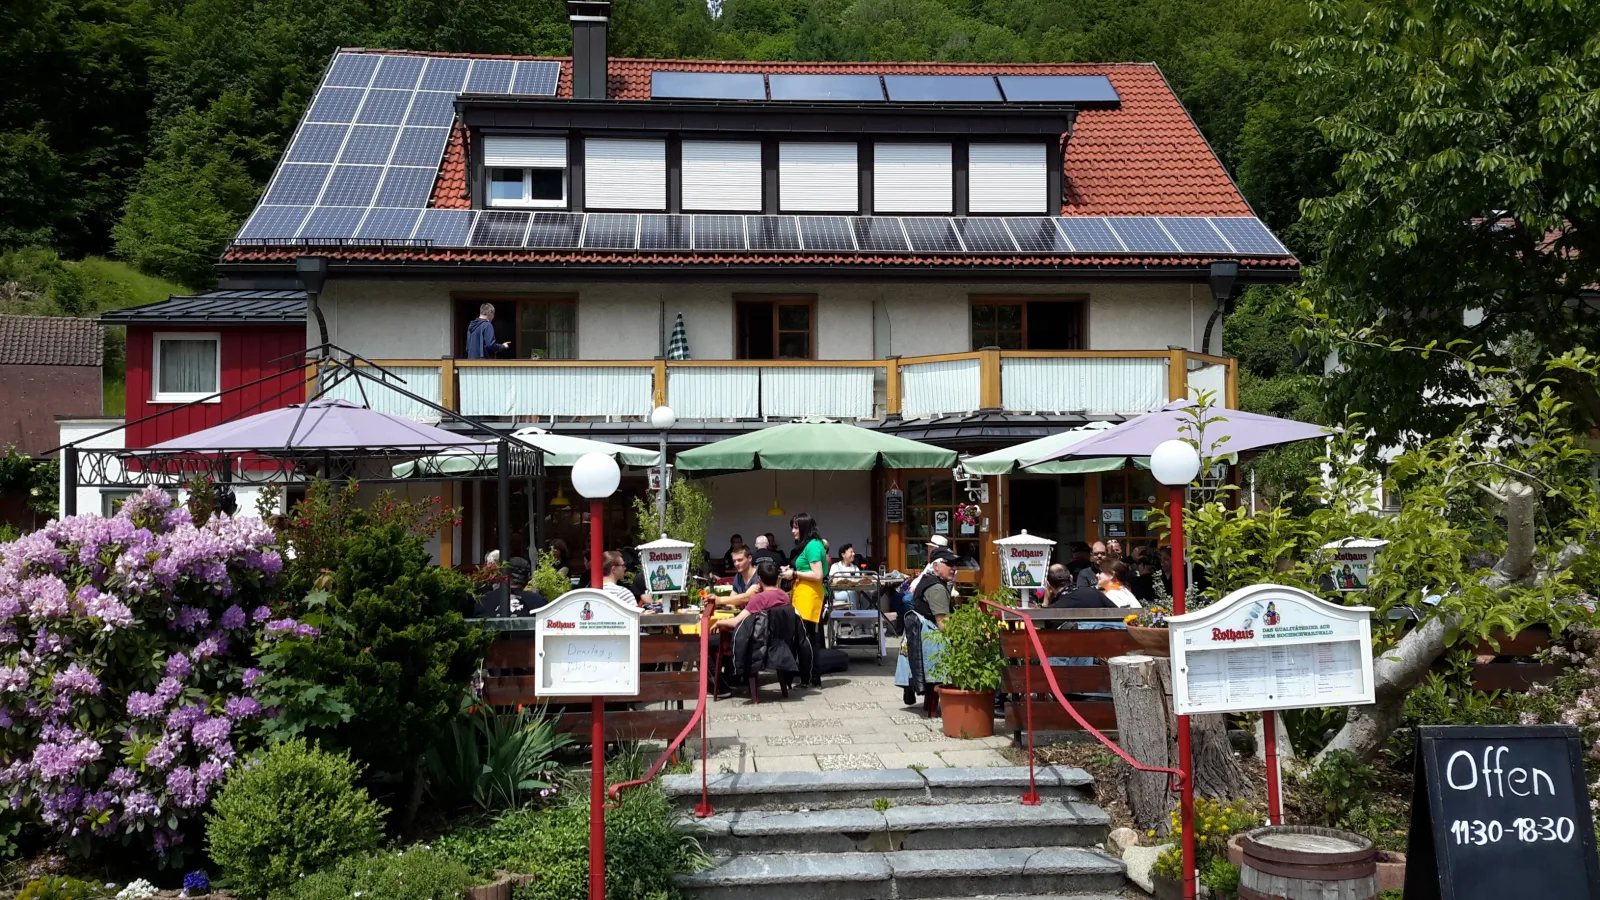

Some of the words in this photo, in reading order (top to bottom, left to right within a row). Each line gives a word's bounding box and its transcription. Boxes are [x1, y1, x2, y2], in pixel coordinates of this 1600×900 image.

[649, 551, 682, 562] Rothaus
[1010, 547, 1043, 558] Rothaus
[546, 619, 576, 632] Rothaus
[1211, 627, 1255, 642] Rothaus
[1446, 745, 1556, 798] Offen
